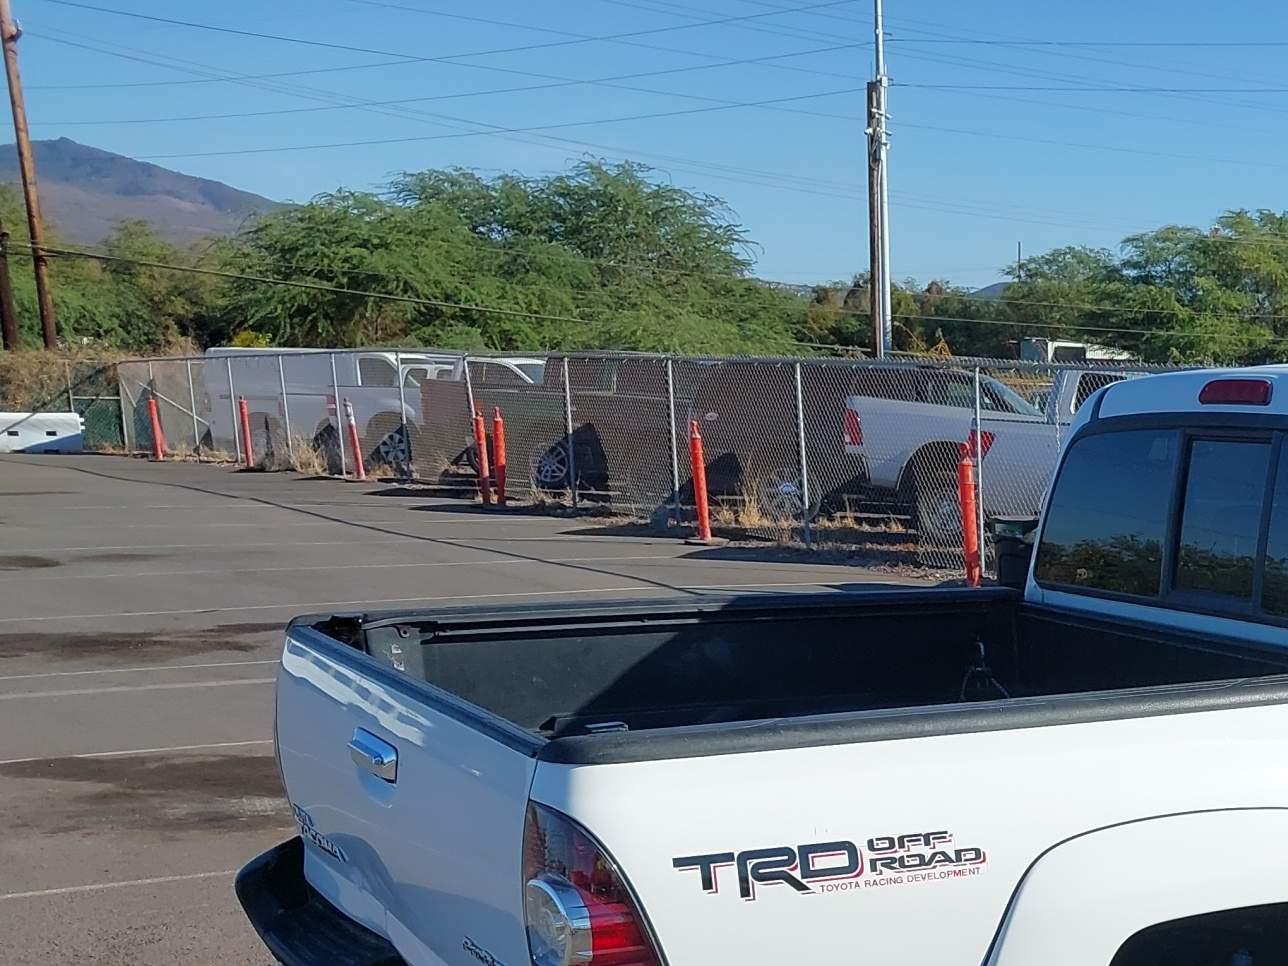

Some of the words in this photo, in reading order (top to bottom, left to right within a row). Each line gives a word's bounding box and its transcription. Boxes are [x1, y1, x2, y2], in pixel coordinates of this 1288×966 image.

[866, 830, 953, 855] OFF
[672, 840, 865, 902] TRD
[869, 847, 986, 876] ROAD
[819, 880, 861, 894] TOYOTA
[864, 876, 904, 889] RACING
[906, 867, 981, 884] DEVELOPMENT
